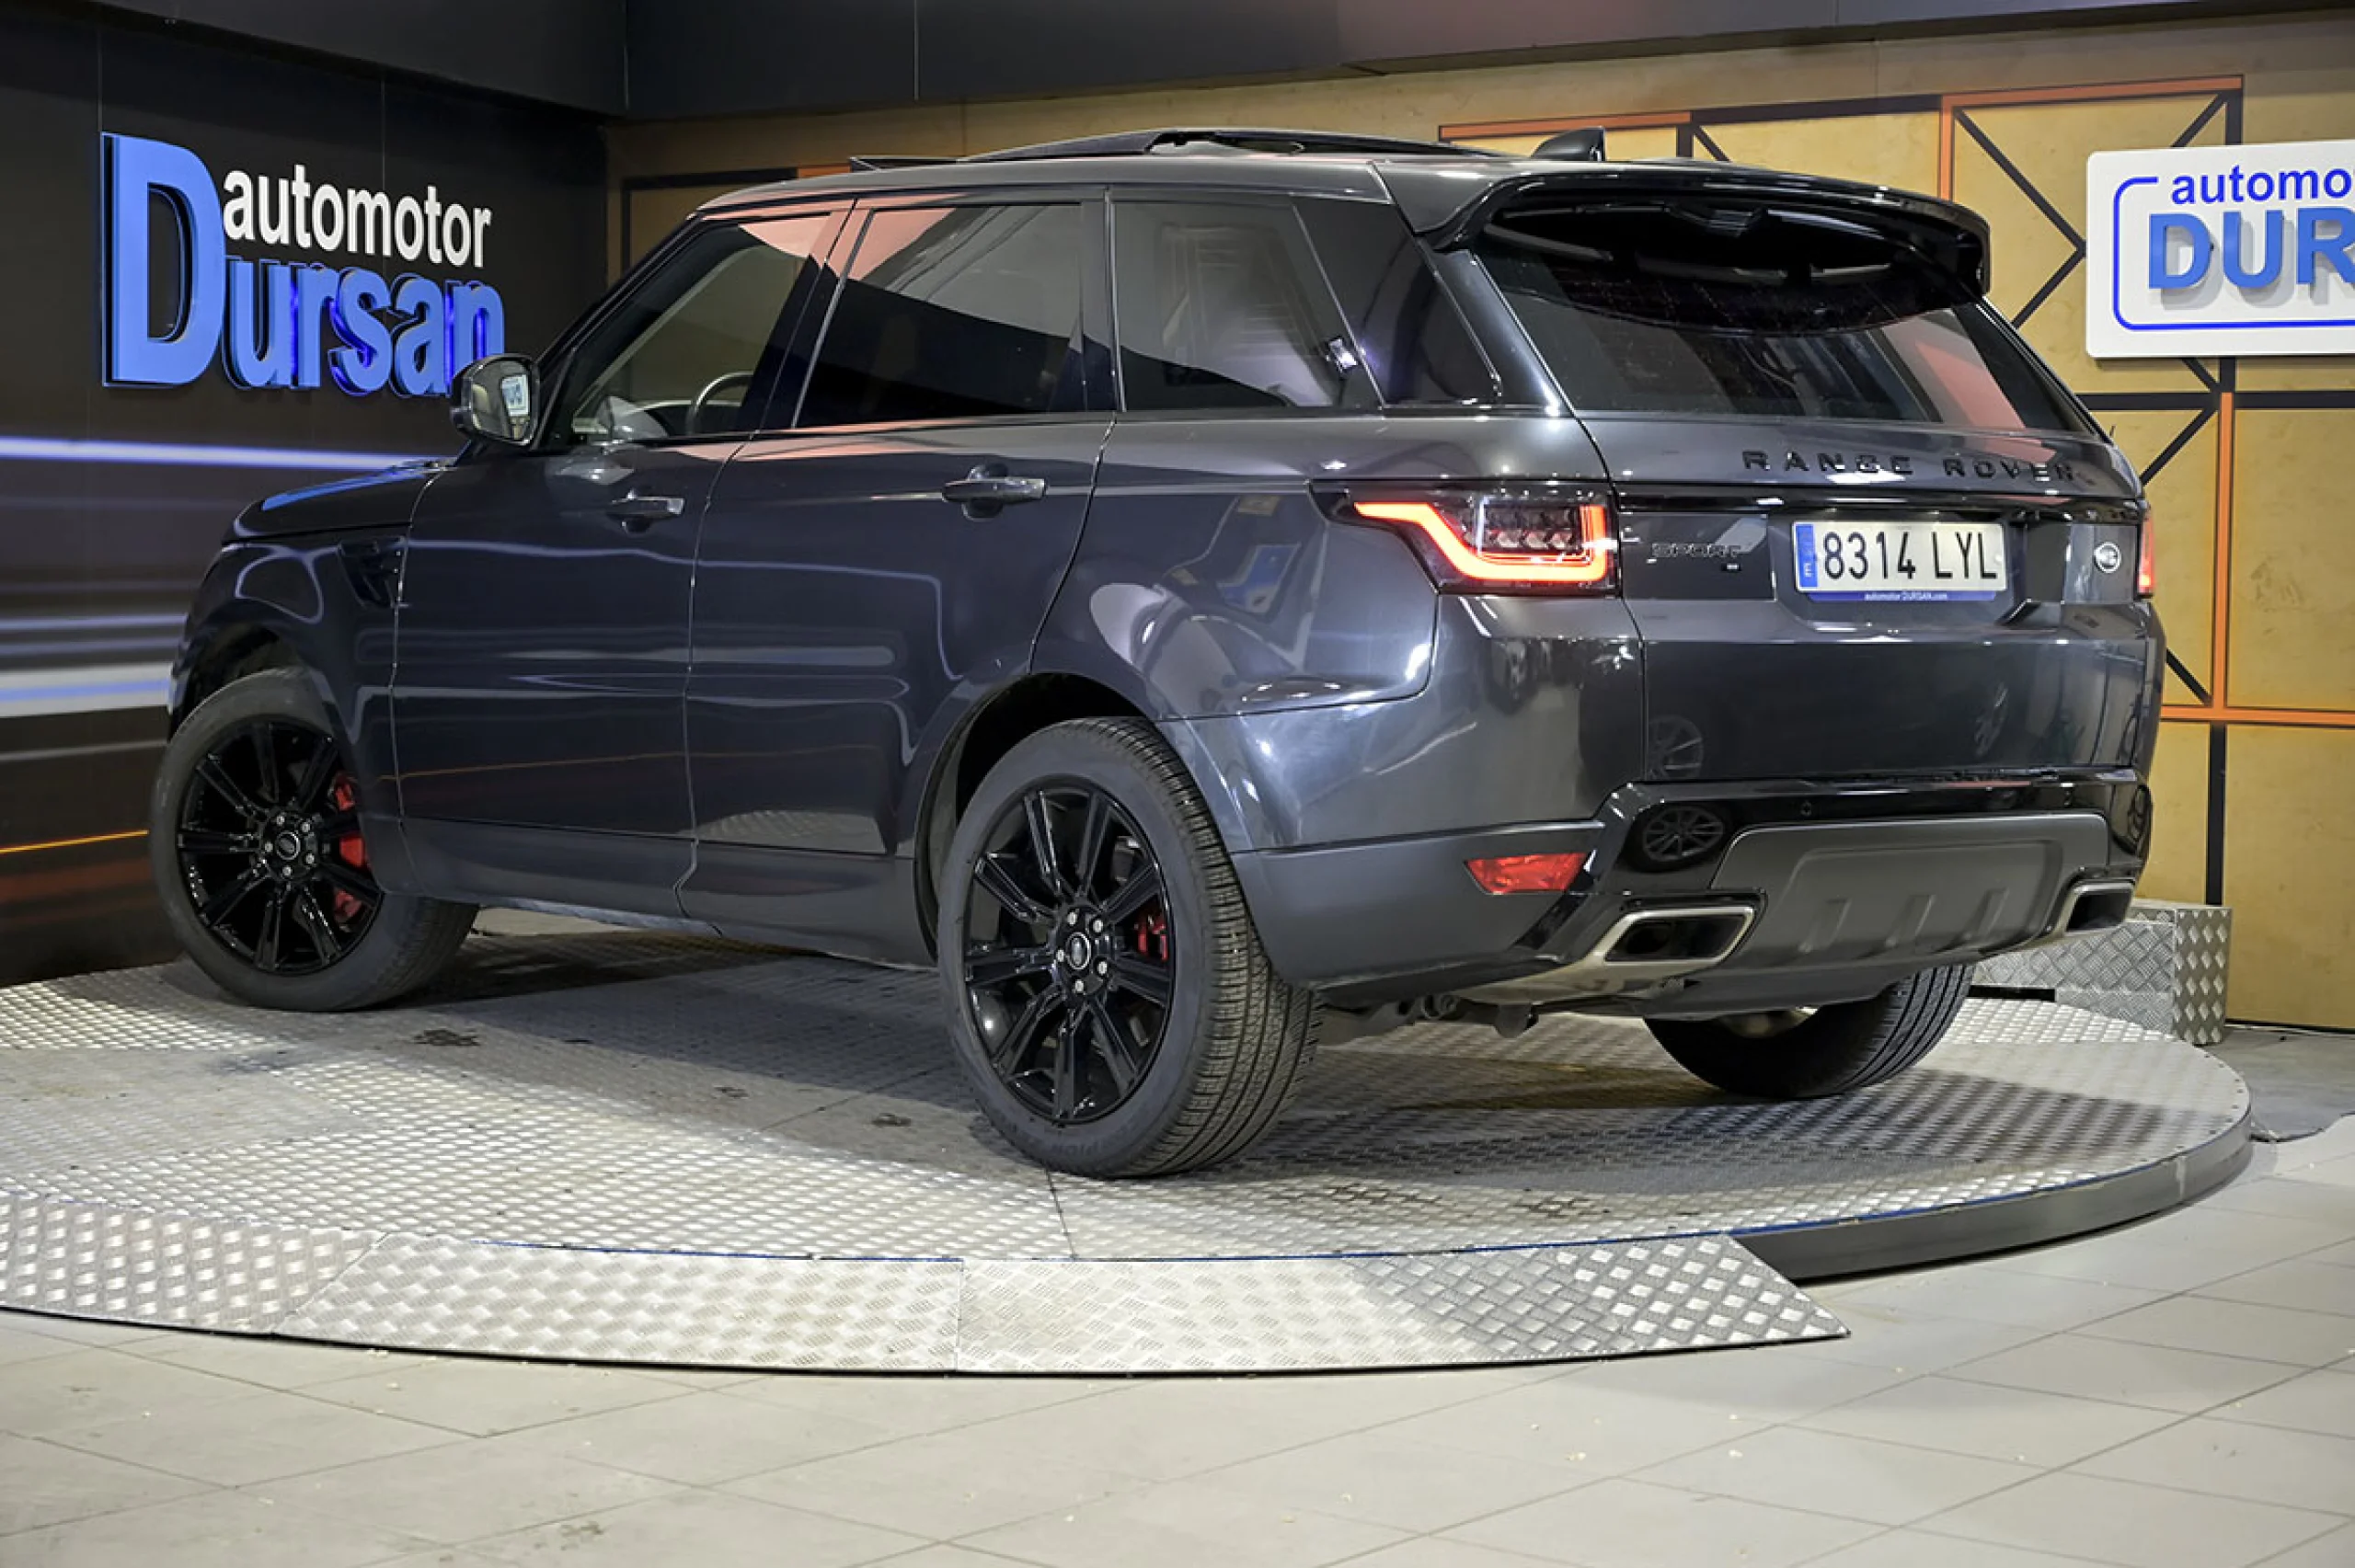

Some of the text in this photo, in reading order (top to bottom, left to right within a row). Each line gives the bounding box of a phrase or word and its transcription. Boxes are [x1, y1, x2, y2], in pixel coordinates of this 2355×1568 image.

[224, 164, 492, 268] automotor
[2148, 206, 2355, 290] DUR
[101, 132, 505, 397] Dursan
[1742, 451, 2074, 481] RANGE ROVER
[1823, 531, 1998, 579] 8314 LYL
